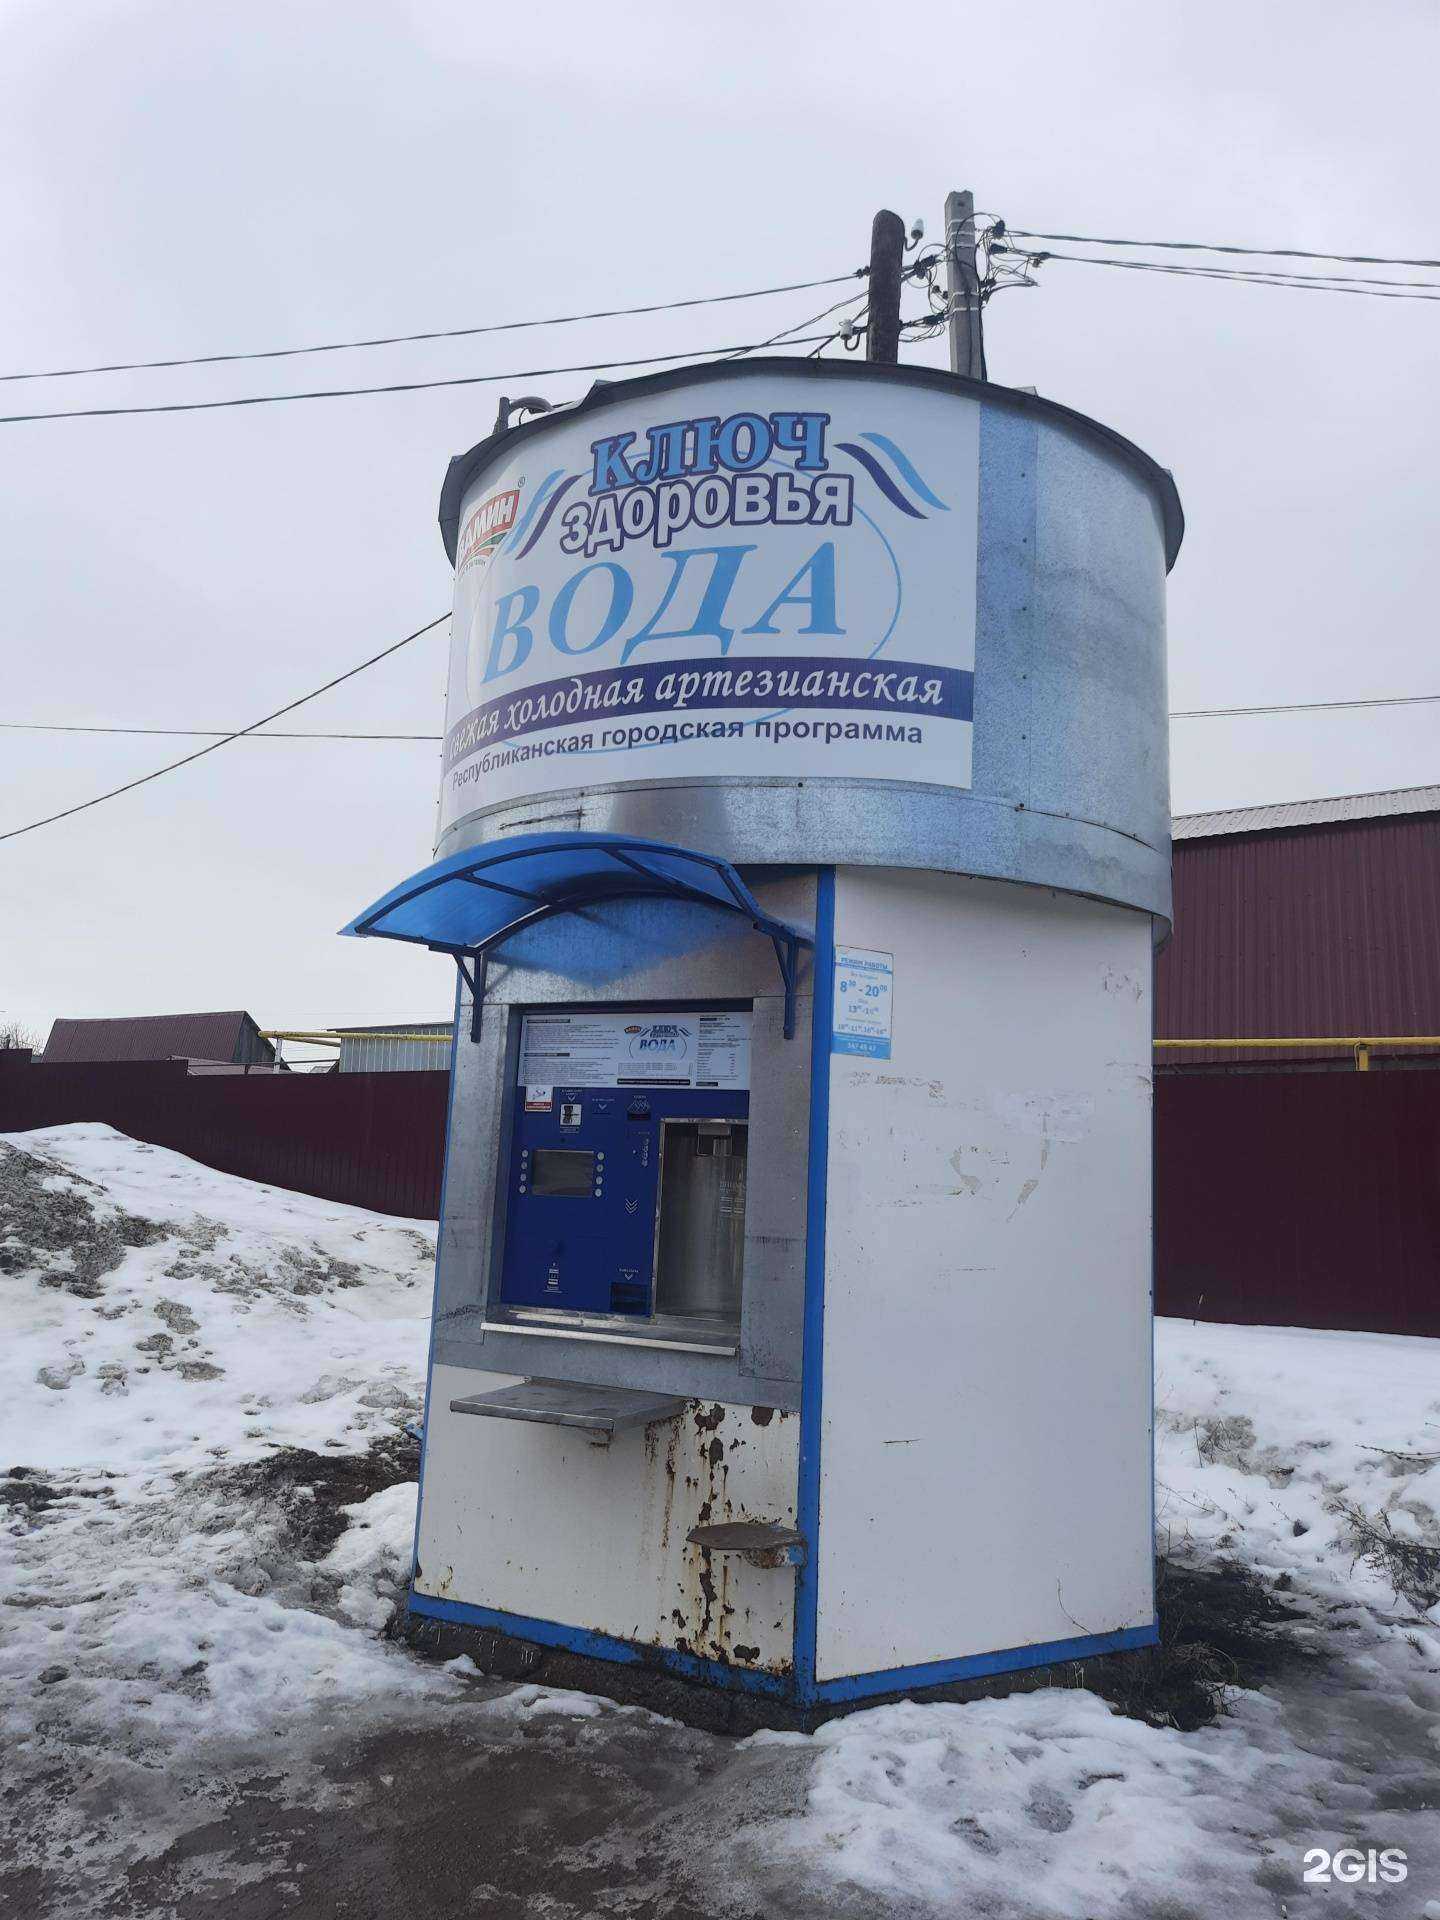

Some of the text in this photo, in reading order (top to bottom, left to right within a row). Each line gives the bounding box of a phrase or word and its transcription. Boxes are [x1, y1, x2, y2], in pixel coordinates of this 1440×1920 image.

[588, 412, 831, 497] КЛЮЧ
[480, 542, 847, 684] ВОДА
[504, 678, 645, 731] холодная
[654, 669, 944, 708] артезианская
[453, 719, 923, 791] Республиканская городская программа
